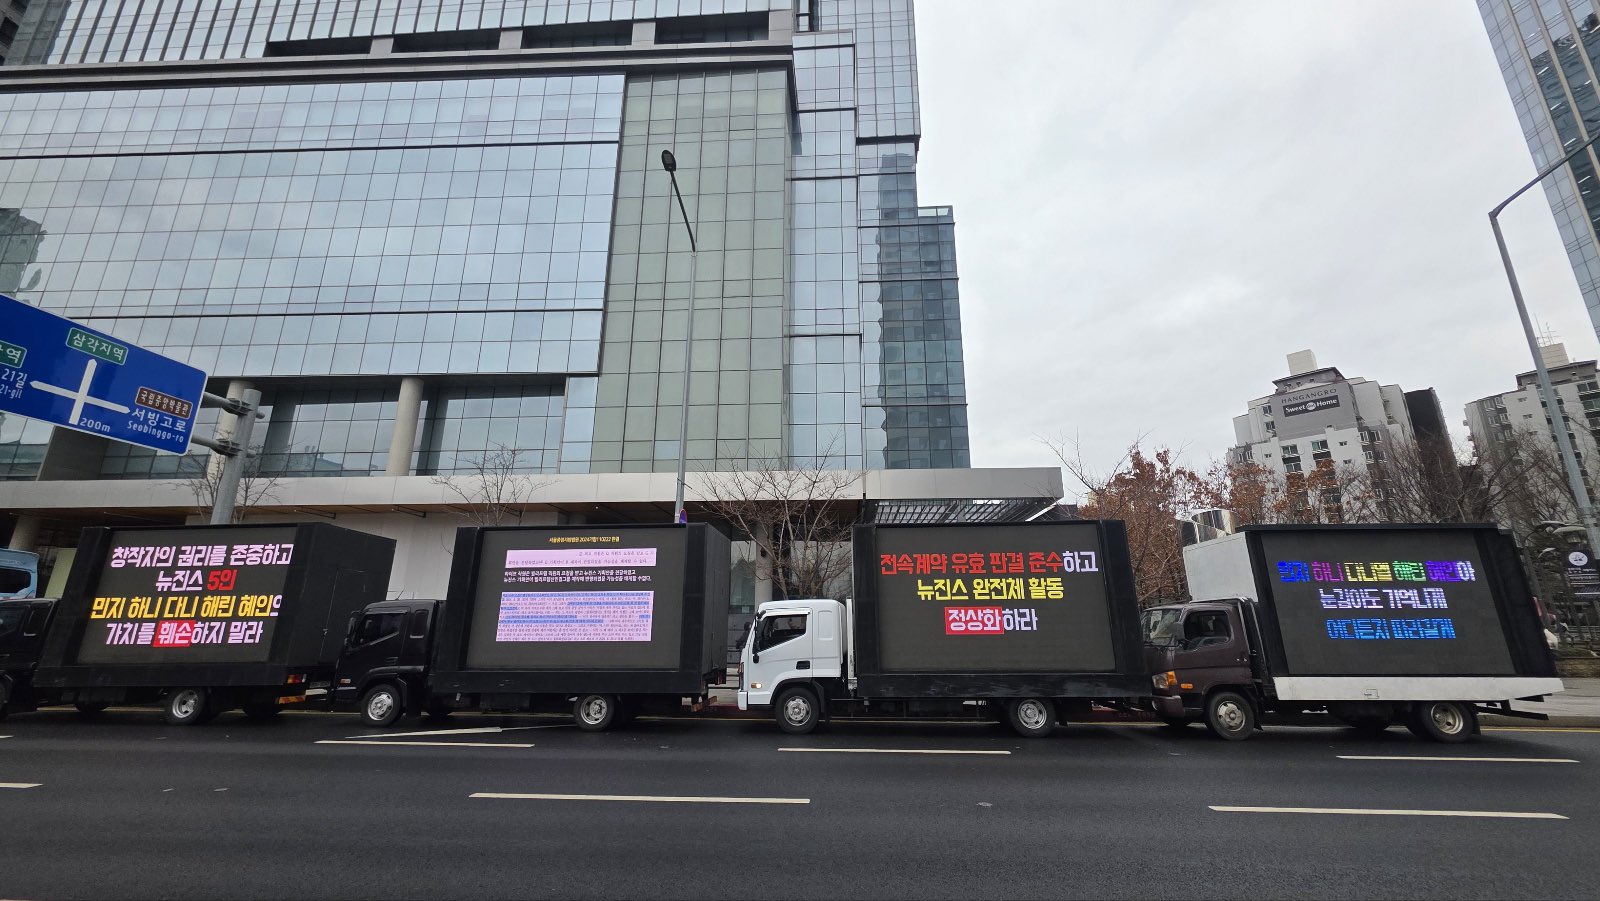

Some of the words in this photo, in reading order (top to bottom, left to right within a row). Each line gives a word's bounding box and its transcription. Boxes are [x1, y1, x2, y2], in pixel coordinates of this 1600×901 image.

[0, 344, 21, 364] 역
[73, 333, 125, 362] 삼각지역
[1, 368, 28, 389] 21길
[0, 384, 23, 399] 21-gil
[141, 390, 189, 416] 국립중앙박물관
[1281, 389, 1337, 404] HANGANGRO
[1285, 404, 1306, 413] Sweet
[1316, 399, 1338, 407] Home
[80, 417, 111, 433] 200m
[127, 420, 184, 443] Seobinggo-ro
[132, 408, 187, 432] 서빙고로
[111, 545, 177, 568] 창작자의
[178, 545, 227, 567] 권리를
[230, 543, 294, 566] 존중하고
[880, 553, 948, 575] 전속계약
[951, 552, 986, 574] 유효
[989, 551, 1025, 574] 판결
[1029, 550, 1098, 573] 준수하고
[155, 569, 203, 592] 뉴진스
[207, 569, 238, 591] 5인
[1277, 561, 1311, 583] 민지
[1311, 560, 1344, 582] 하니
[1344, 561, 1393, 582] 다니엘
[917, 578, 968, 600] 뉴진스
[972, 577, 1025, 600] 완전체
[1028, 577, 1064, 599] 활동
[90, 596, 126, 619] 민지
[127, 596, 163, 619] 하니
[163, 596, 199, 619] 다니
[201, 595, 237, 618] 해린
[948, 607, 1039, 631] 정상화하라
[106, 621, 156, 645] 가치를
[158, 620, 227, 645] 훼손하지
[228, 620, 264, 644] 말라
